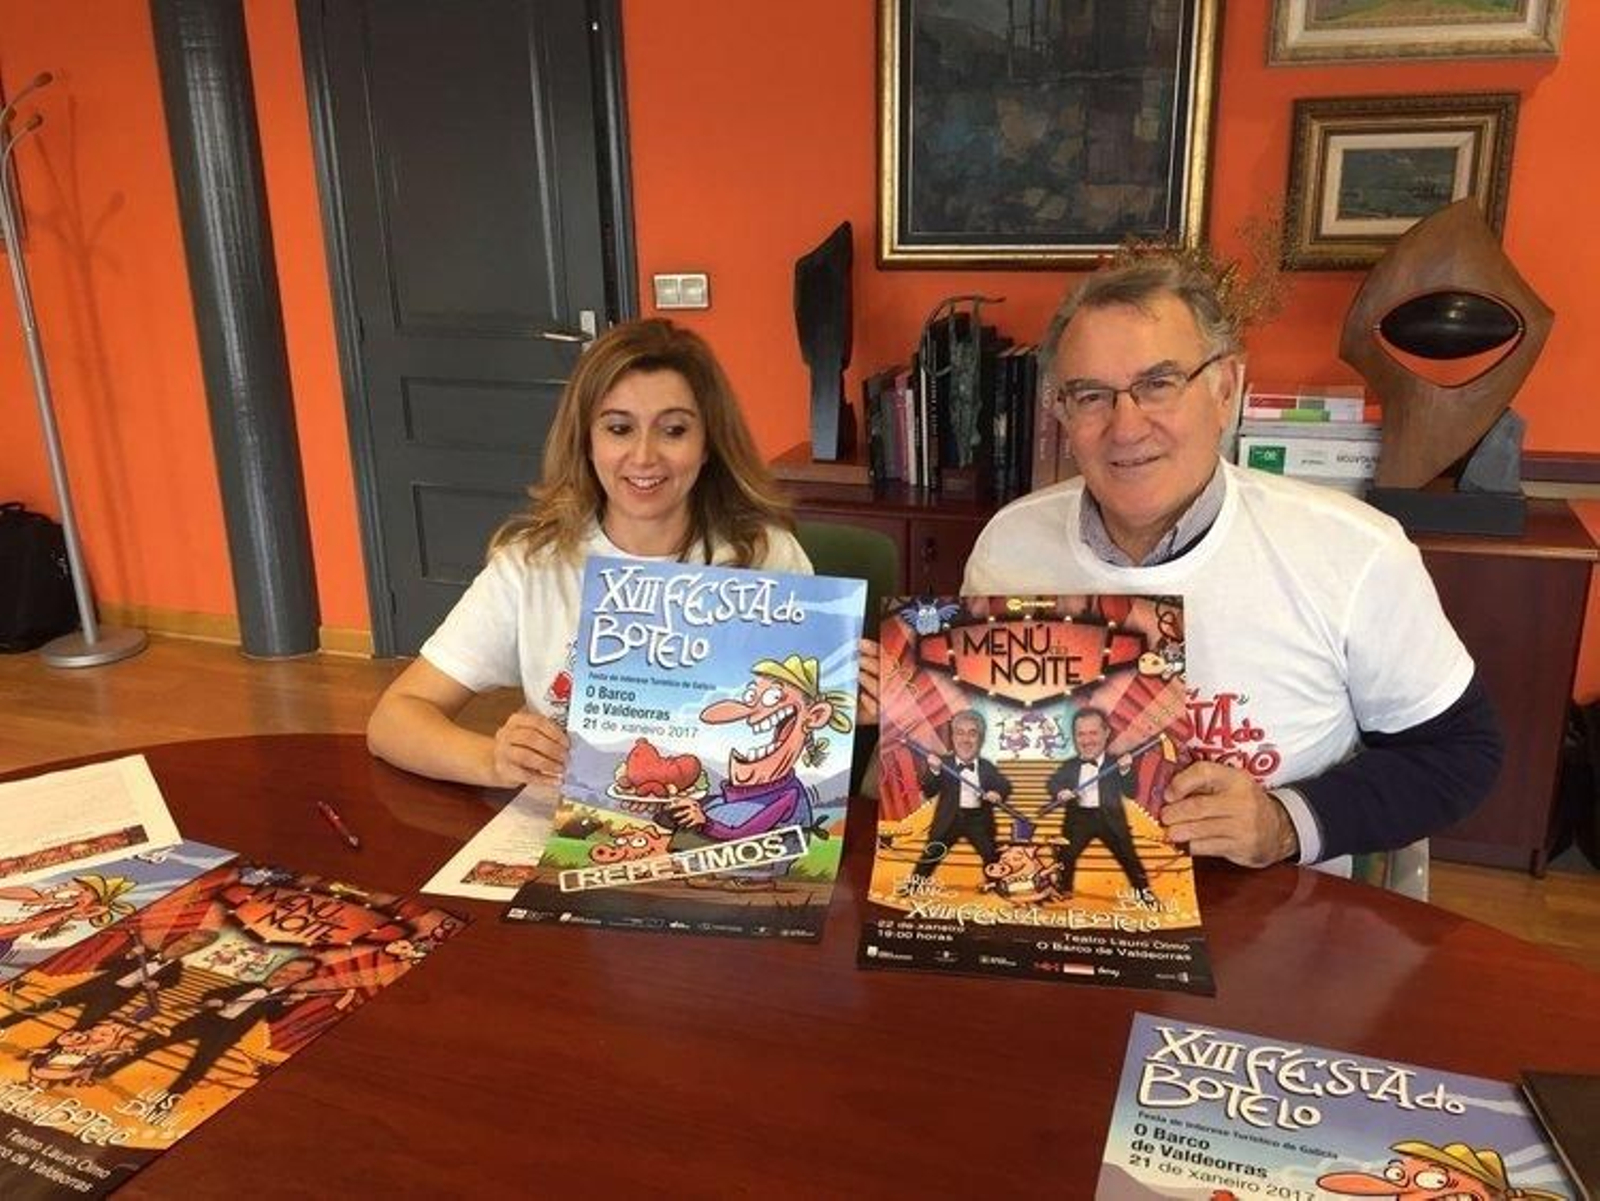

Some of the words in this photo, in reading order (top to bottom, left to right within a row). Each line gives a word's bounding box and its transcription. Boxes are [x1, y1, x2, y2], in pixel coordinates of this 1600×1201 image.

[593, 566, 664, 614] XVII
[663, 573, 779, 634] FESTA
[773, 591, 806, 624] do
[588, 615, 710, 668] BOTELO
[963, 624, 1051, 656] MENÚ
[991, 656, 1081, 685] NOITE
[586, 685, 595, 697] O
[598, 686, 636, 701] Barco
[583, 702, 600, 714] de
[602, 703, 670, 720] Valdeorras
[583, 718, 597, 729] 21
[600, 720, 618, 731] de
[622, 723, 665, 735] xaneiro
[667, 726, 699, 738] 2017
[579, 835, 788, 887] REPETIMOS
[897, 922, 914, 930] de
[916, 931, 954, 942] horas
[1064, 933, 1107, 945] Teatro
[1036, 941, 1049, 950] O
[1053, 942, 1092, 954] Barco
[1096, 947, 1113, 955] de
[1117, 948, 1192, 961] Valdeorras
[1147, 1026, 1246, 1075] XVII
[1244, 1045, 1417, 1110] FESTA
[1416, 1082, 1468, 1114] do
[1138, 1060, 1322, 1131] BOTELO
[1134, 1123, 1147, 1137] O
[1153, 1127, 1211, 1150] Barco
[1138, 1111, 1166, 1122] Festa
[1170, 1116, 1182, 1126] de
[1283, 1142, 1297, 1150] de
[1300, 1145, 1339, 1160] Galicia
[1131, 1139, 1155, 1154] de
[1161, 1144, 1269, 1179] Valdeorras
[1129, 1153, 1151, 1168] 21
[1158, 1162, 1183, 1176] de
[1189, 1170, 1260, 1193] xaneiro
[1266, 1184, 1317, 1201] 2017
